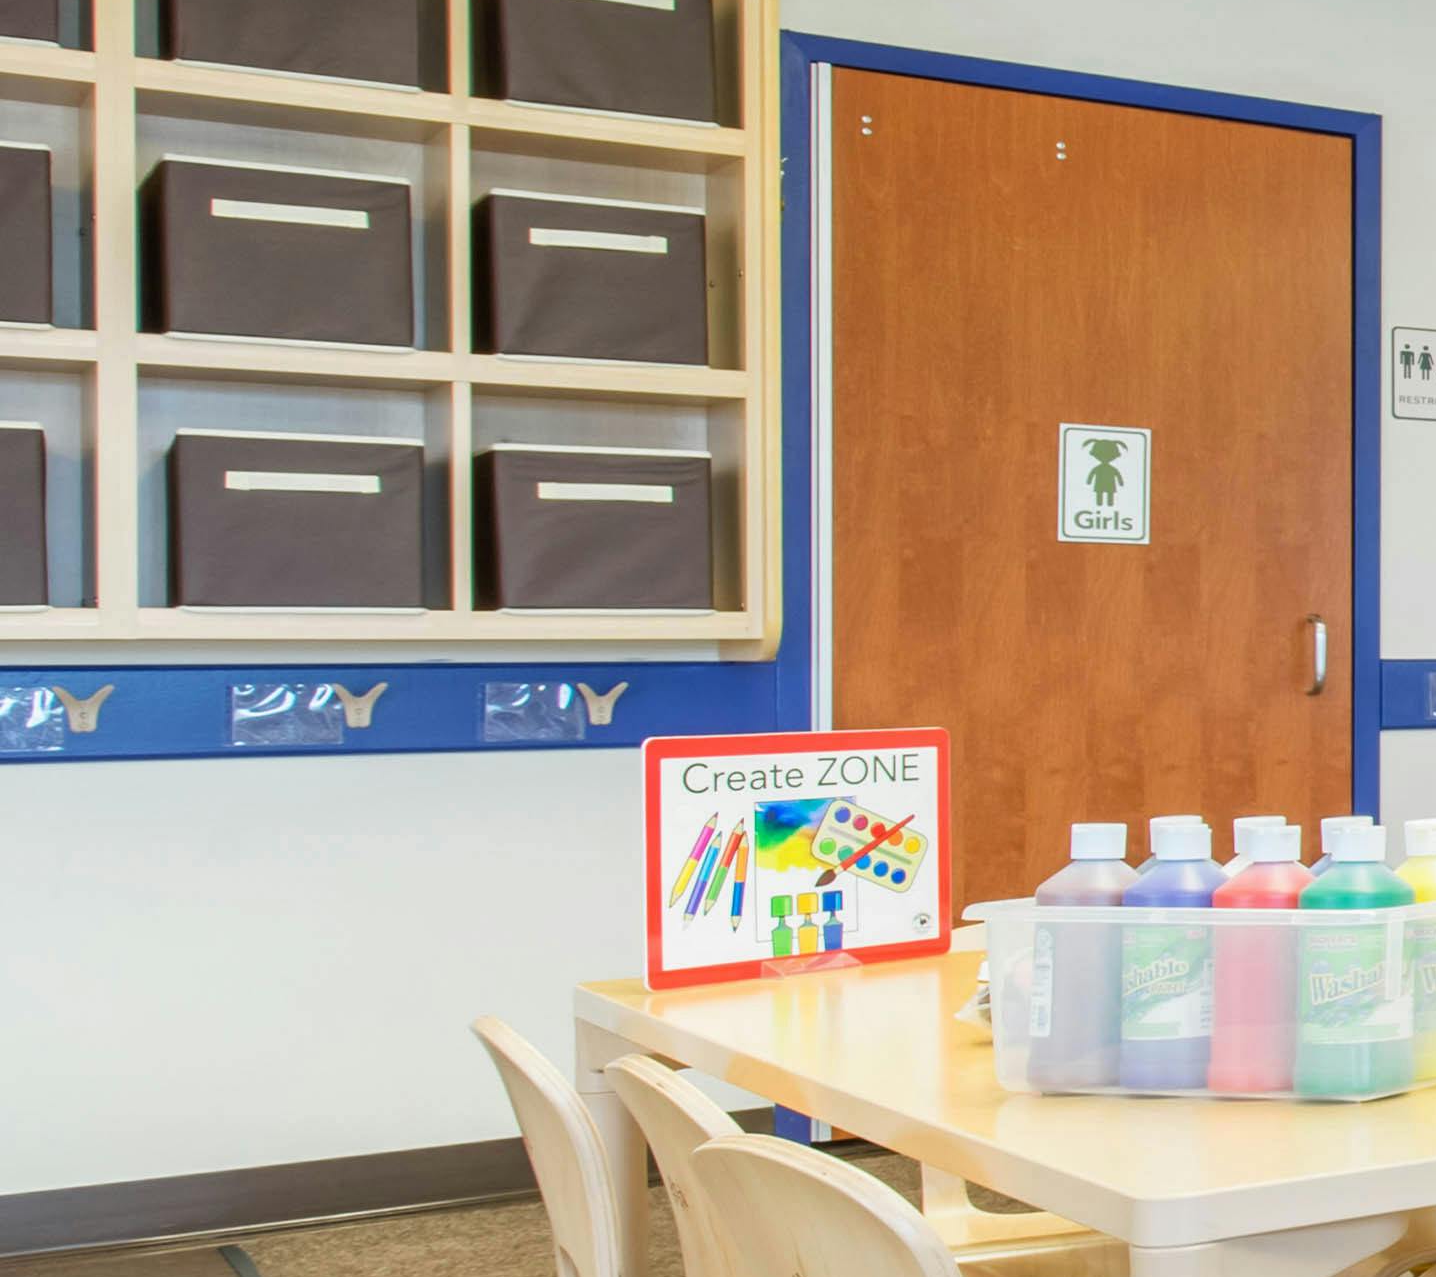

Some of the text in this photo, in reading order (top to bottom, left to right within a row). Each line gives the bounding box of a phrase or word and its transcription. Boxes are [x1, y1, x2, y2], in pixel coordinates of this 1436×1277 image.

[1073, 510, 1134, 531] Girls
[682, 753, 920, 794] Create ZONE
